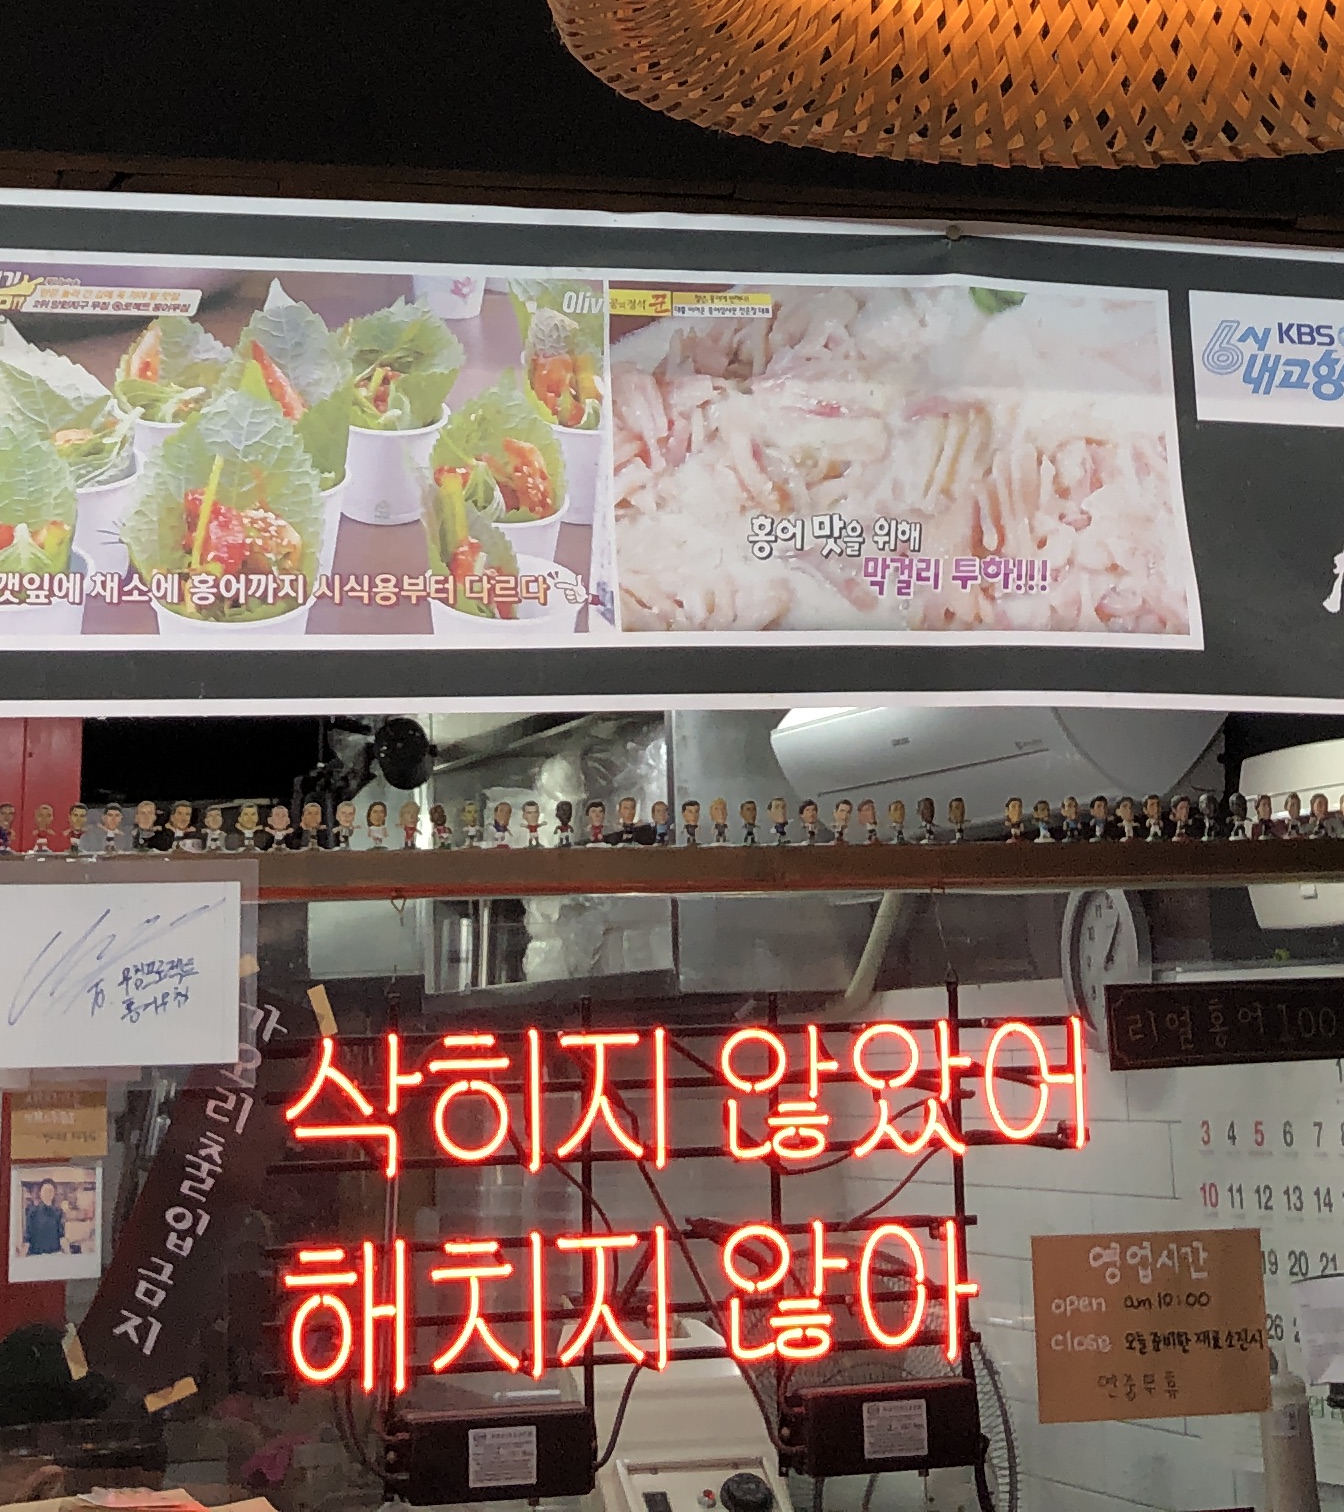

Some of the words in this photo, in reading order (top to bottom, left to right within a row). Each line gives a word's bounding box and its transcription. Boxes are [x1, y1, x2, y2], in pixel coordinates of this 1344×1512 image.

[1277, 322, 1332, 348] KBS
[747, 515, 804, 559] 홍어
[812, 514, 865, 558] 맛을
[872, 517, 922, 551] 위해
[90, 572, 180, 606] 채소에
[189, 572, 306, 606] 홍어까지
[314, 571, 455, 606] 시식용부터
[464, 572, 551, 606] 다르다
[862, 557, 940, 597] 막걸리
[952, 557, 1049, 592] 투하!!!
[283, 1023, 671, 1179] 삭히지
[719, 1016, 1089, 1161] 않았어
[1200, 1120, 1211, 1146] 3
[1227, 1120, 1237, 1146] 4
[1254, 1120, 1265, 1146] 5
[1282, 1121, 1294, 1147] 6
[1313, 1121, 1323, 1147] 7
[1199, 1182, 1219, 1208] 10
[1227, 1183, 1244, 1209] 11
[1255, 1184, 1273, 1210] 12
[1283, 1184, 1304, 1211] 13
[1313, 1186, 1333, 1213] 14
[1088, 1241, 1208, 1285] 영업시간
[1287, 1250, 1309, 1277] 20
[283, 1225, 671, 1396] 해치지
[720, 1218, 980, 1363] 않아
[1051, 1295, 1106, 1317] open
